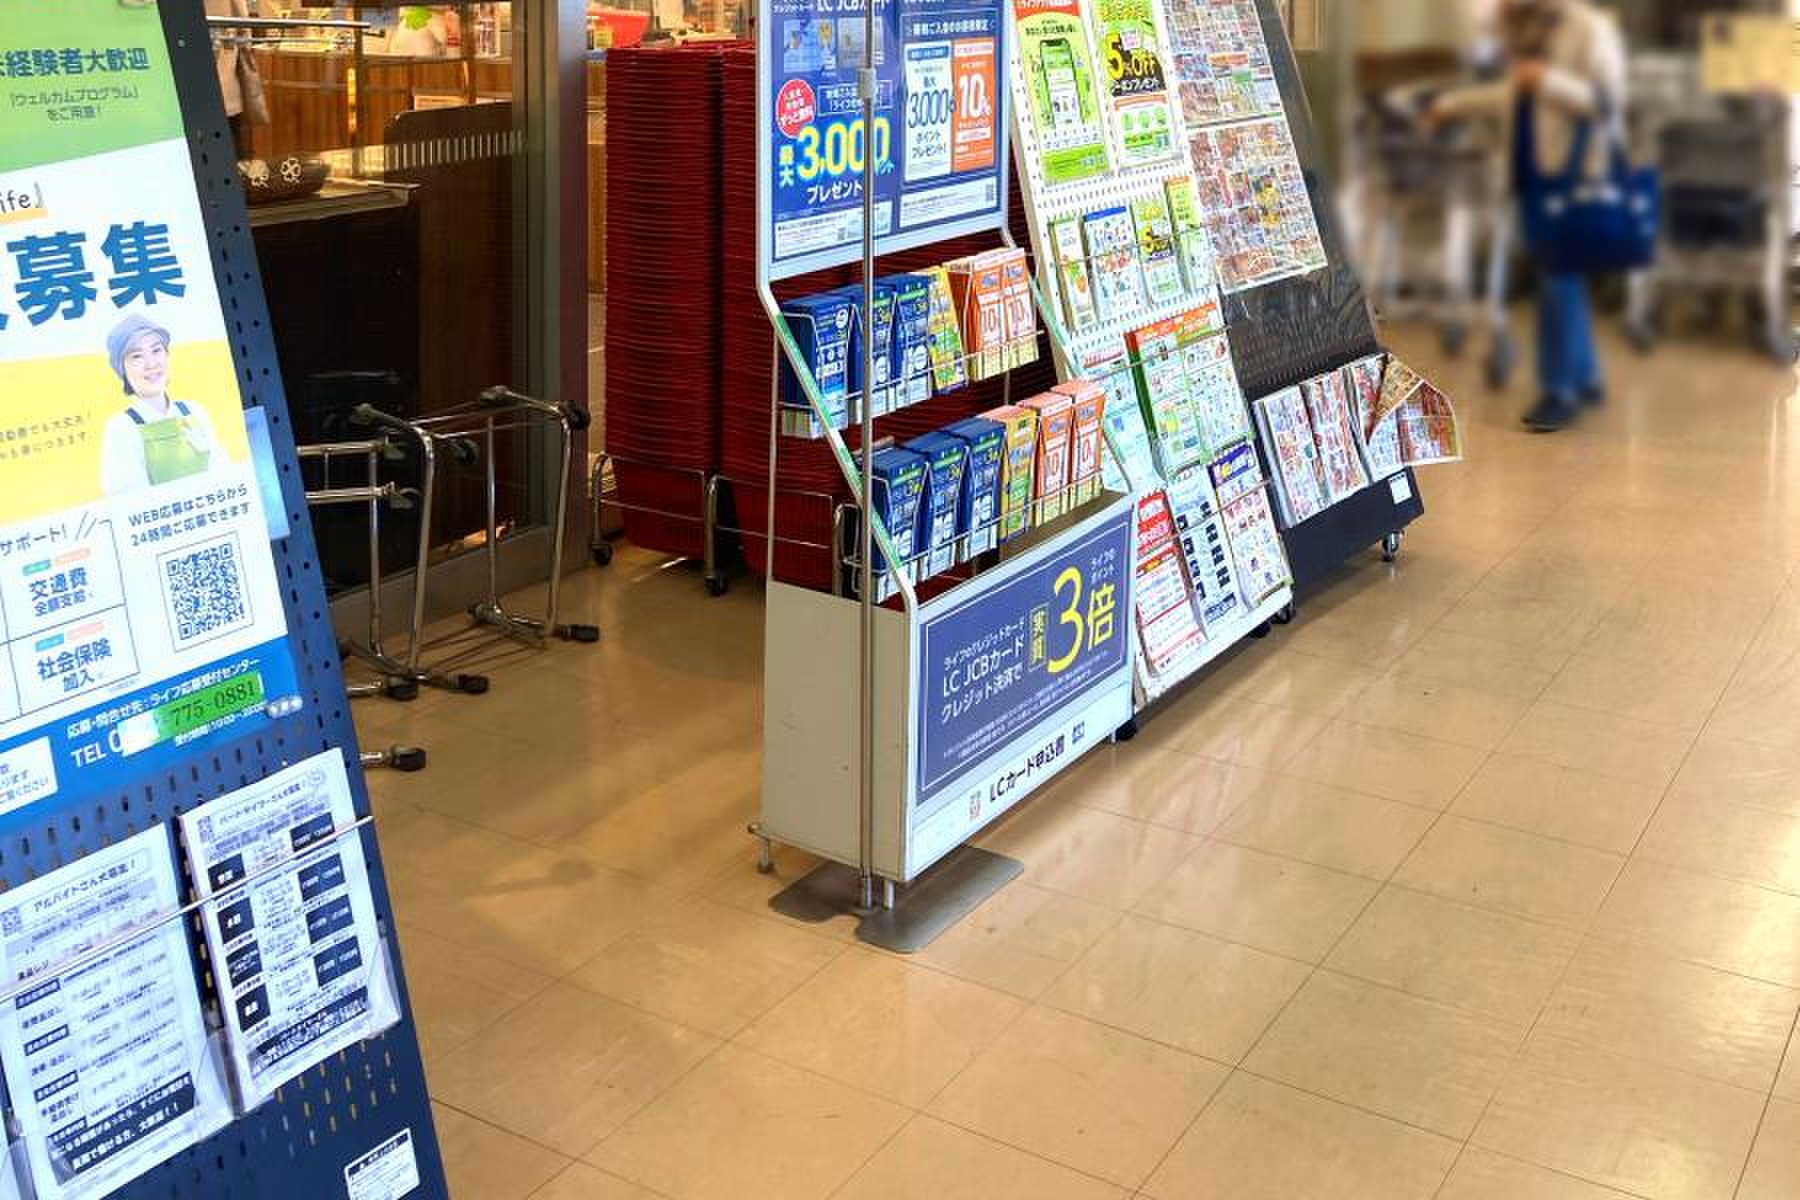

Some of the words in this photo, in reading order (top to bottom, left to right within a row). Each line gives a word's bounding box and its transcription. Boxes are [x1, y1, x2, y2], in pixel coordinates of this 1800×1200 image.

[943, 669, 961, 697] LC
[963, 633, 1025, 686] JCBカード
[71, 742, 107, 768] TEL
